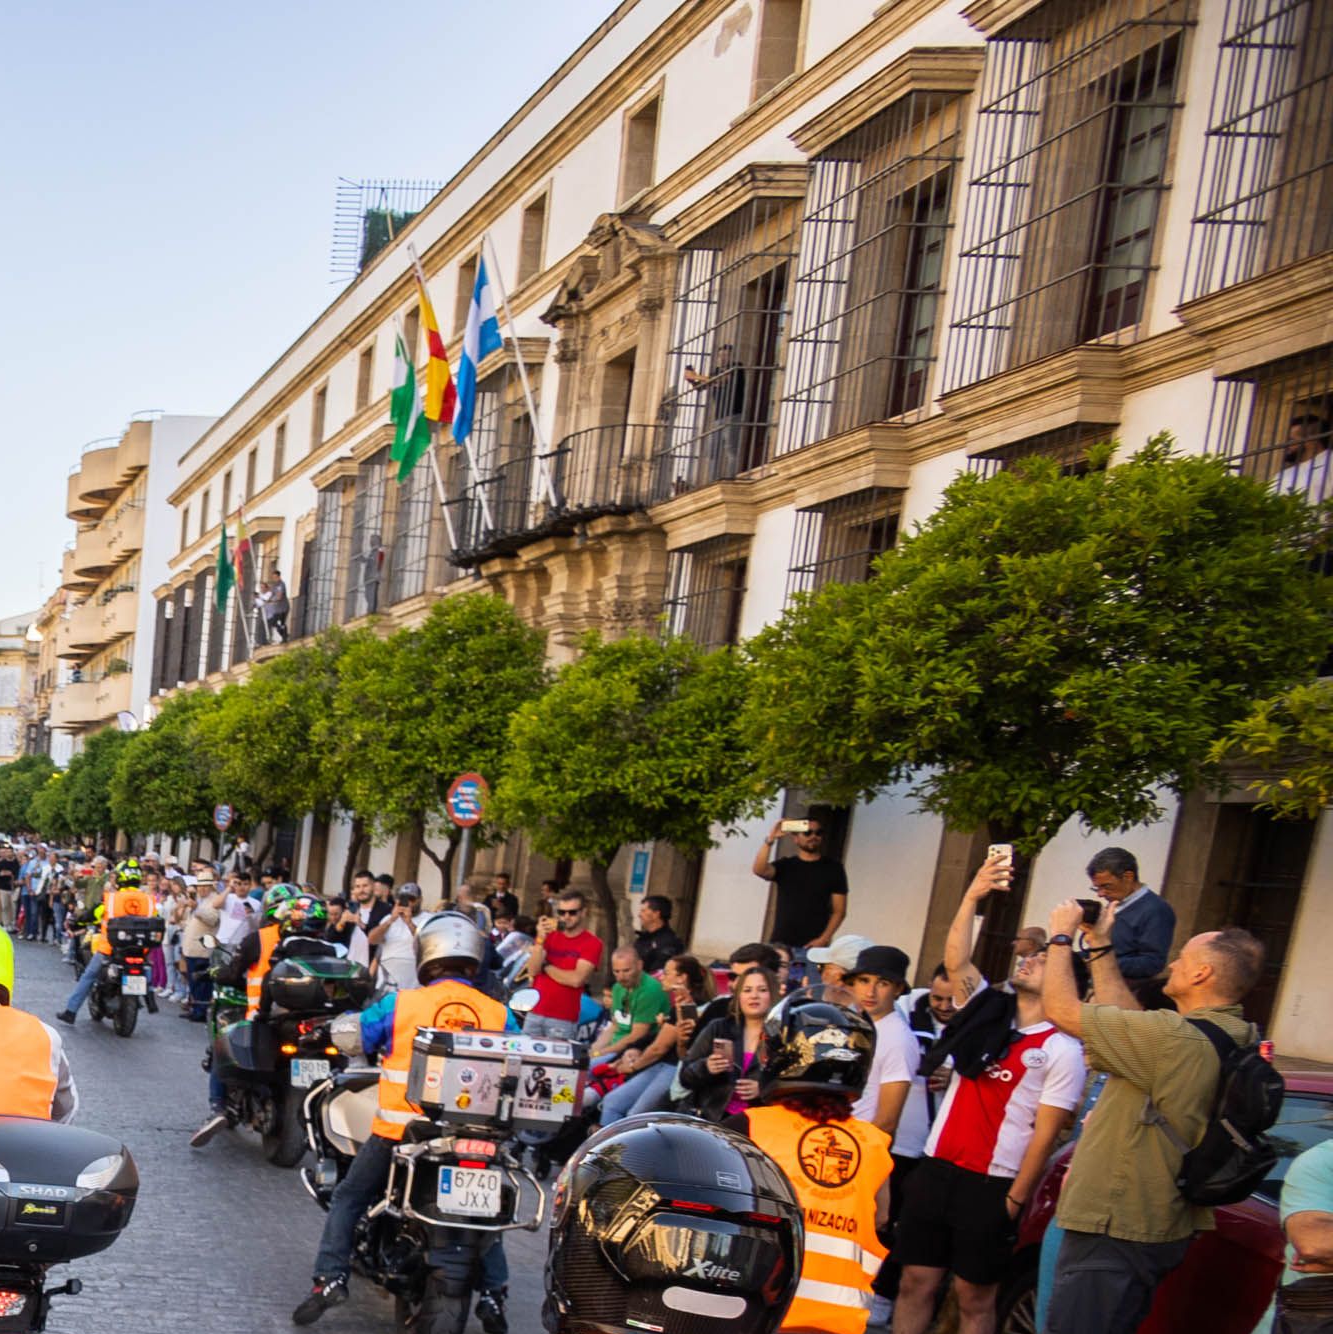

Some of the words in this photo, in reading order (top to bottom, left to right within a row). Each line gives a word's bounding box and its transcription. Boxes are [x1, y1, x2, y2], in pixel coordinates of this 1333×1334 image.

[454, 1170, 498, 1191] 6740
[19, 1185, 68, 1198] SHAD
[458, 1191, 491, 1208] JXX
[682, 1257, 741, 1281] X-lite
